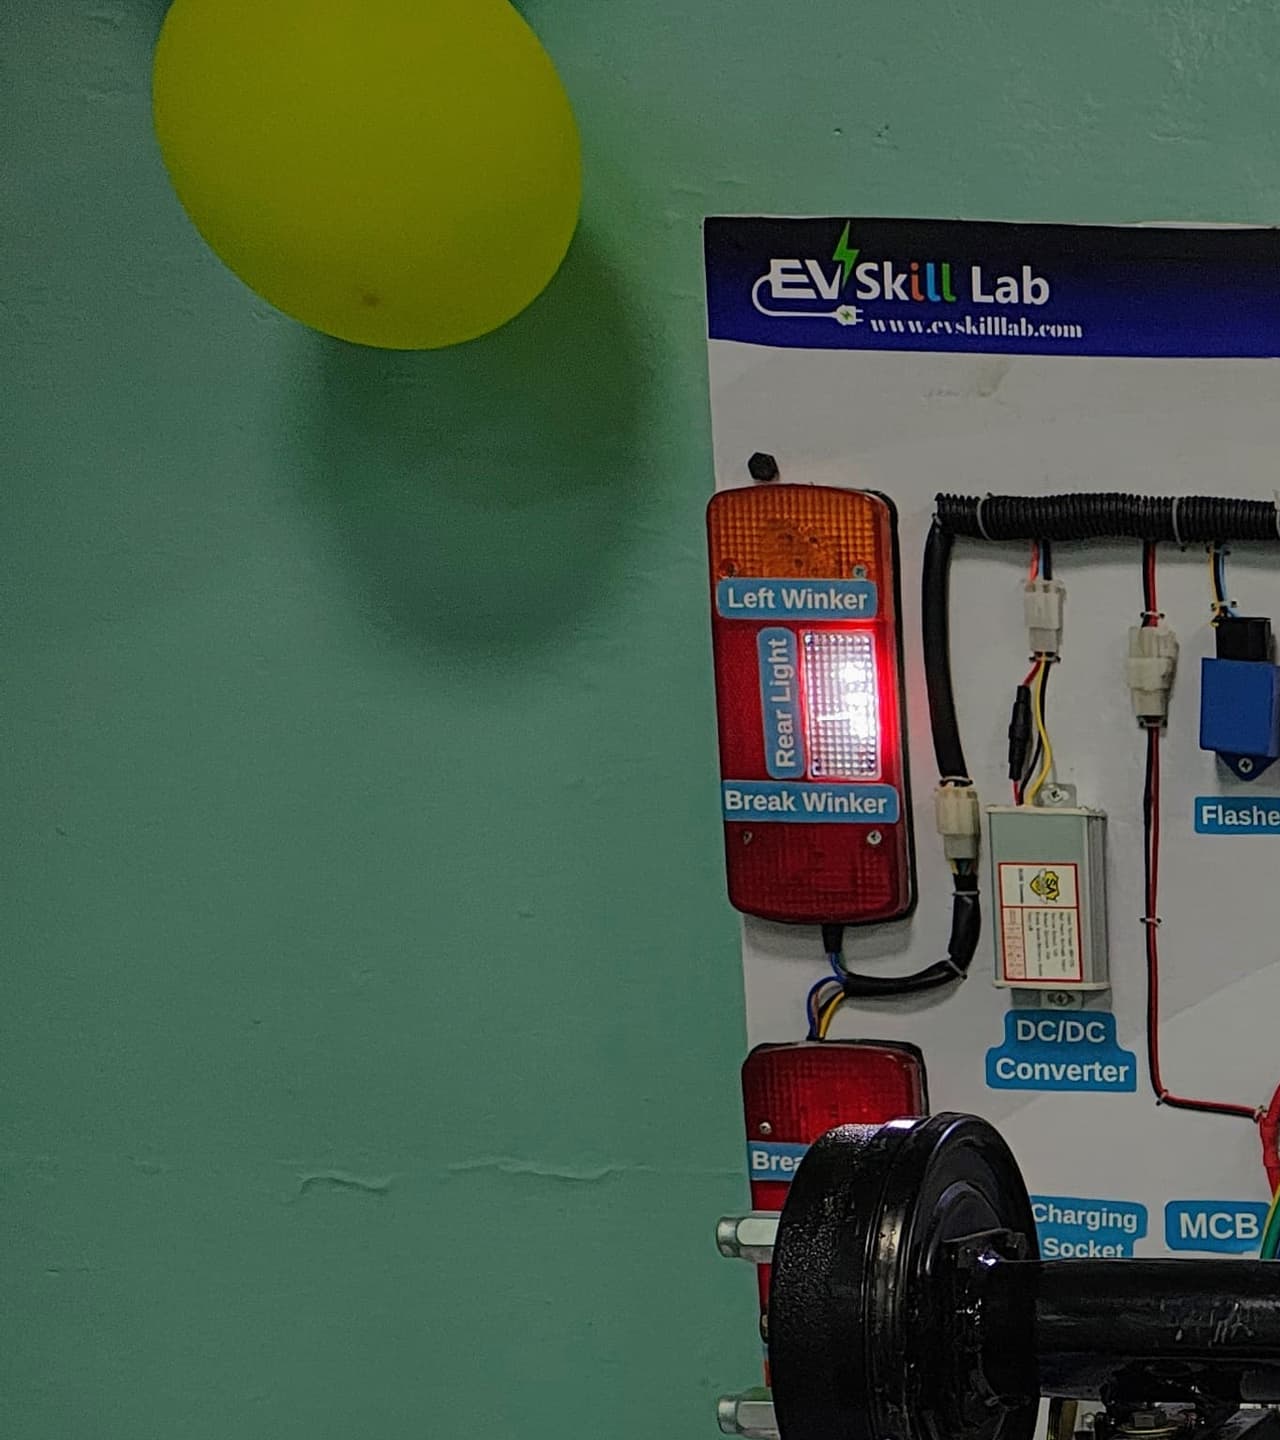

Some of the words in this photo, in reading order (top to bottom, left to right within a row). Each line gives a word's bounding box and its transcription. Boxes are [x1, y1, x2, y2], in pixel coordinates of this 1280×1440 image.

[971, 265, 1050, 305] Lab
[870, 315, 1084, 339] www.evskilllab.com
[727, 587, 775, 609] Left
[781, 588, 868, 611] Winker
[767, 637, 796, 704] Light
[775, 710, 796, 769] Rear
[725, 789, 797, 812] Break
[801, 791, 888, 815] Winker
[1015, 1018, 1107, 1045] DC/DC
[994, 1056, 1130, 1084] Converter
[1031, 1203, 1139, 1234] Charging
[1179, 1212, 1260, 1240] MCB
[1042, 1237, 1125, 1259] Socket
